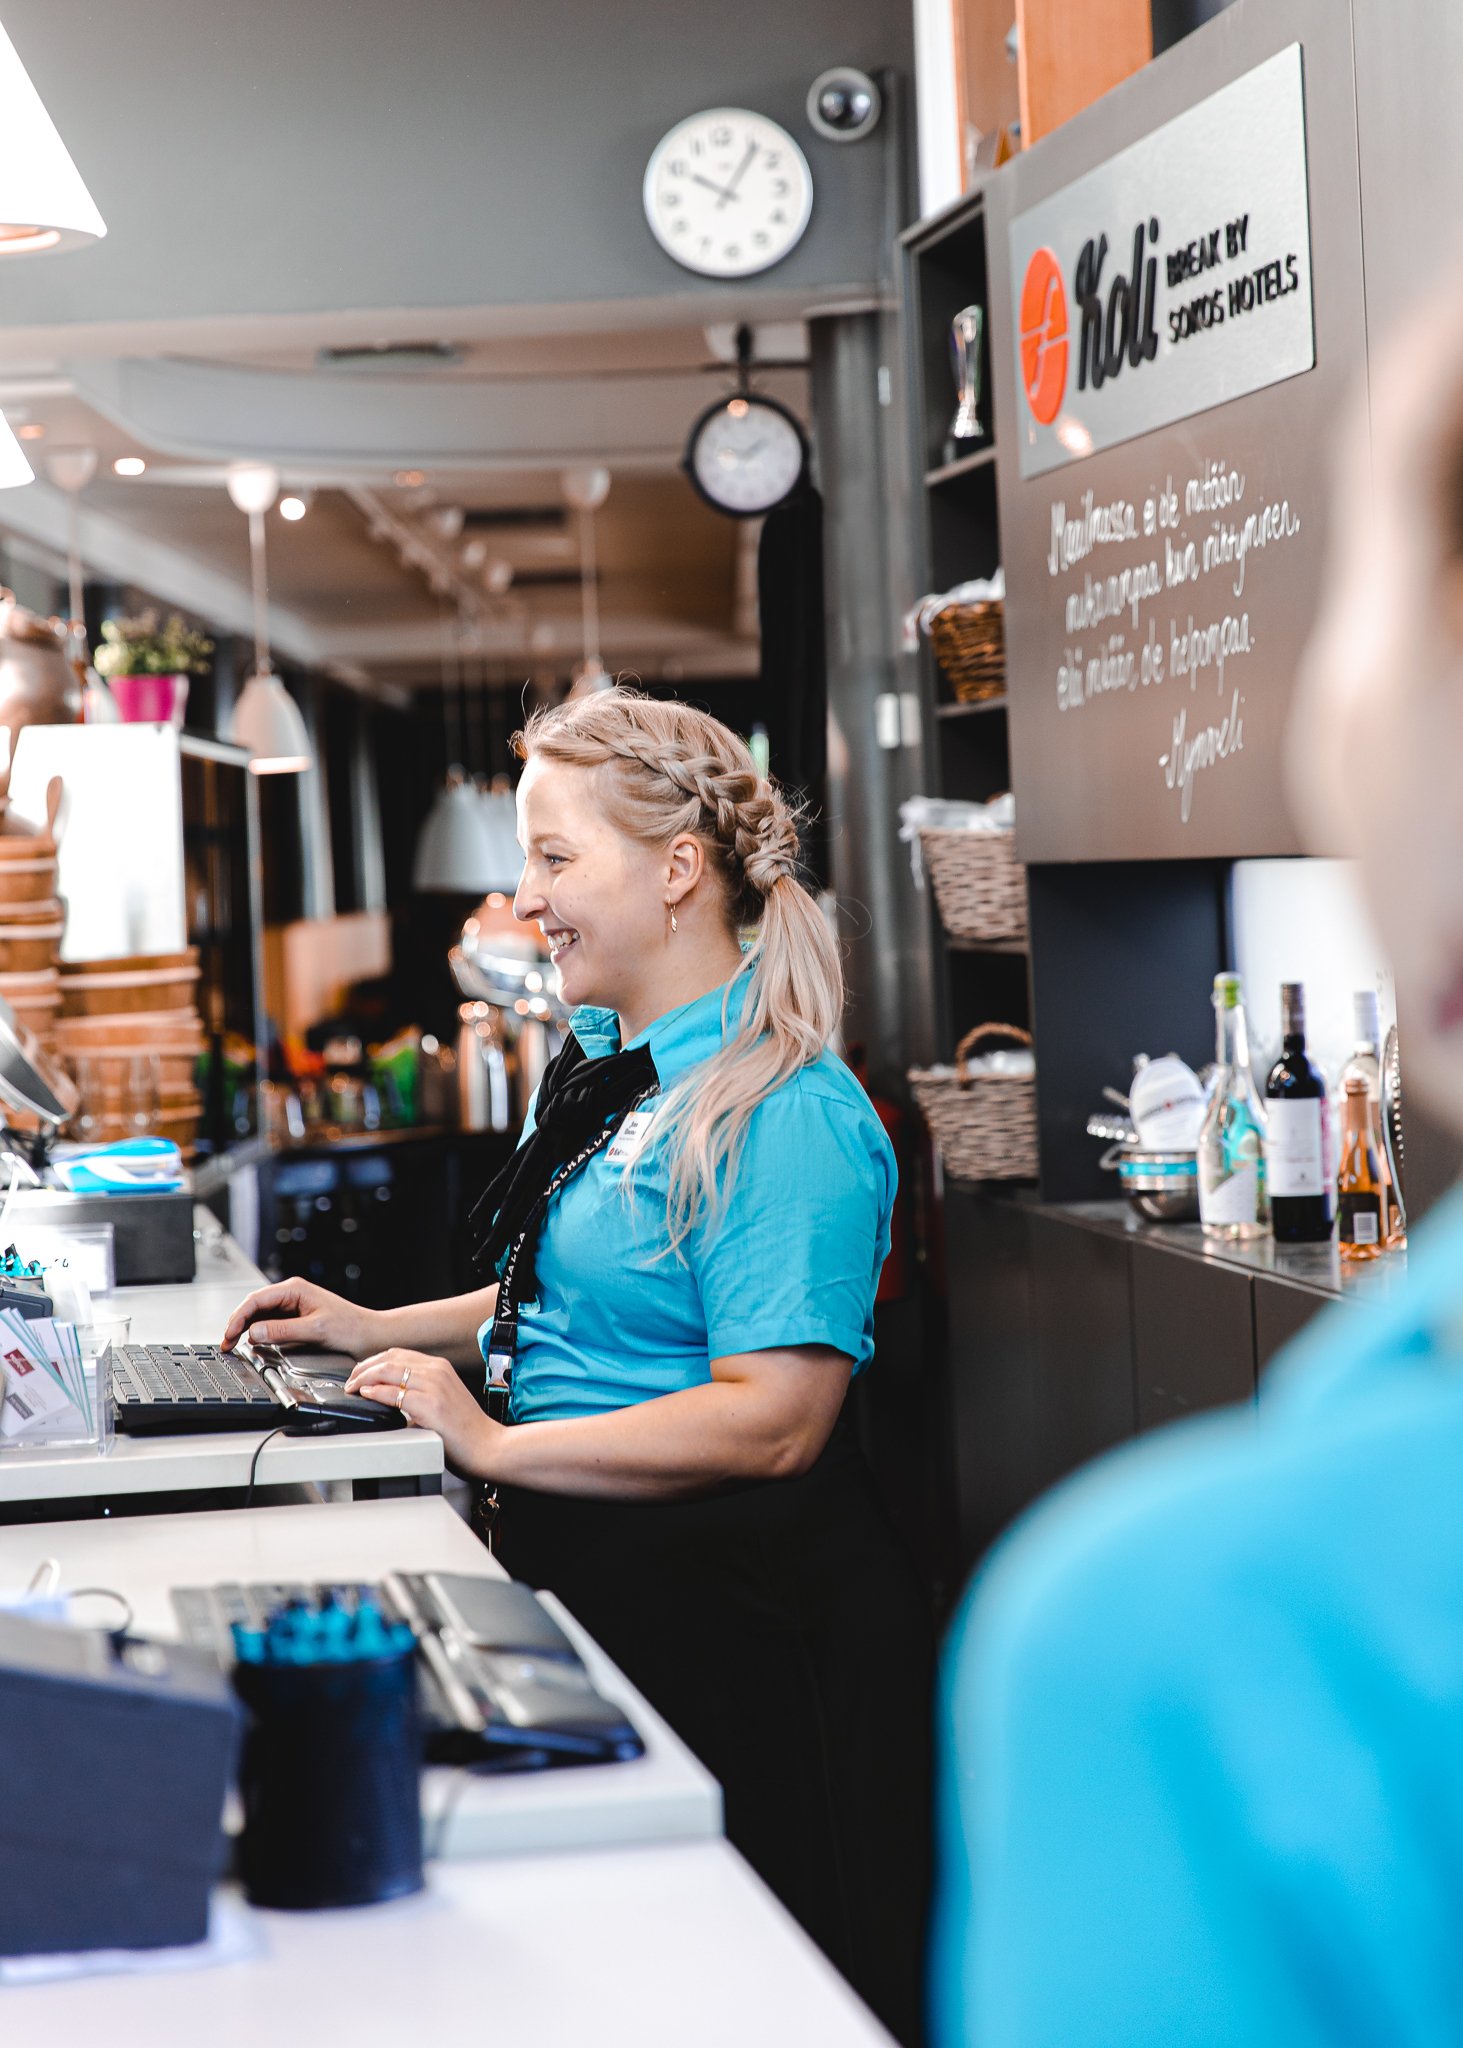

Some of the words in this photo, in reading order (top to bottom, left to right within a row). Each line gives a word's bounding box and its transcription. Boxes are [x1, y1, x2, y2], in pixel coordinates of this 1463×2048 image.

[1167, 229, 1221, 287] BREAK
[1226, 214, 1248, 258] BY
[1169, 289, 1225, 343] SOKOS
[1229, 254, 1298, 318] HOTELS
[543, 1129, 611, 1196] VALHALLA
[501, 1232, 526, 1318] VALHALLA
